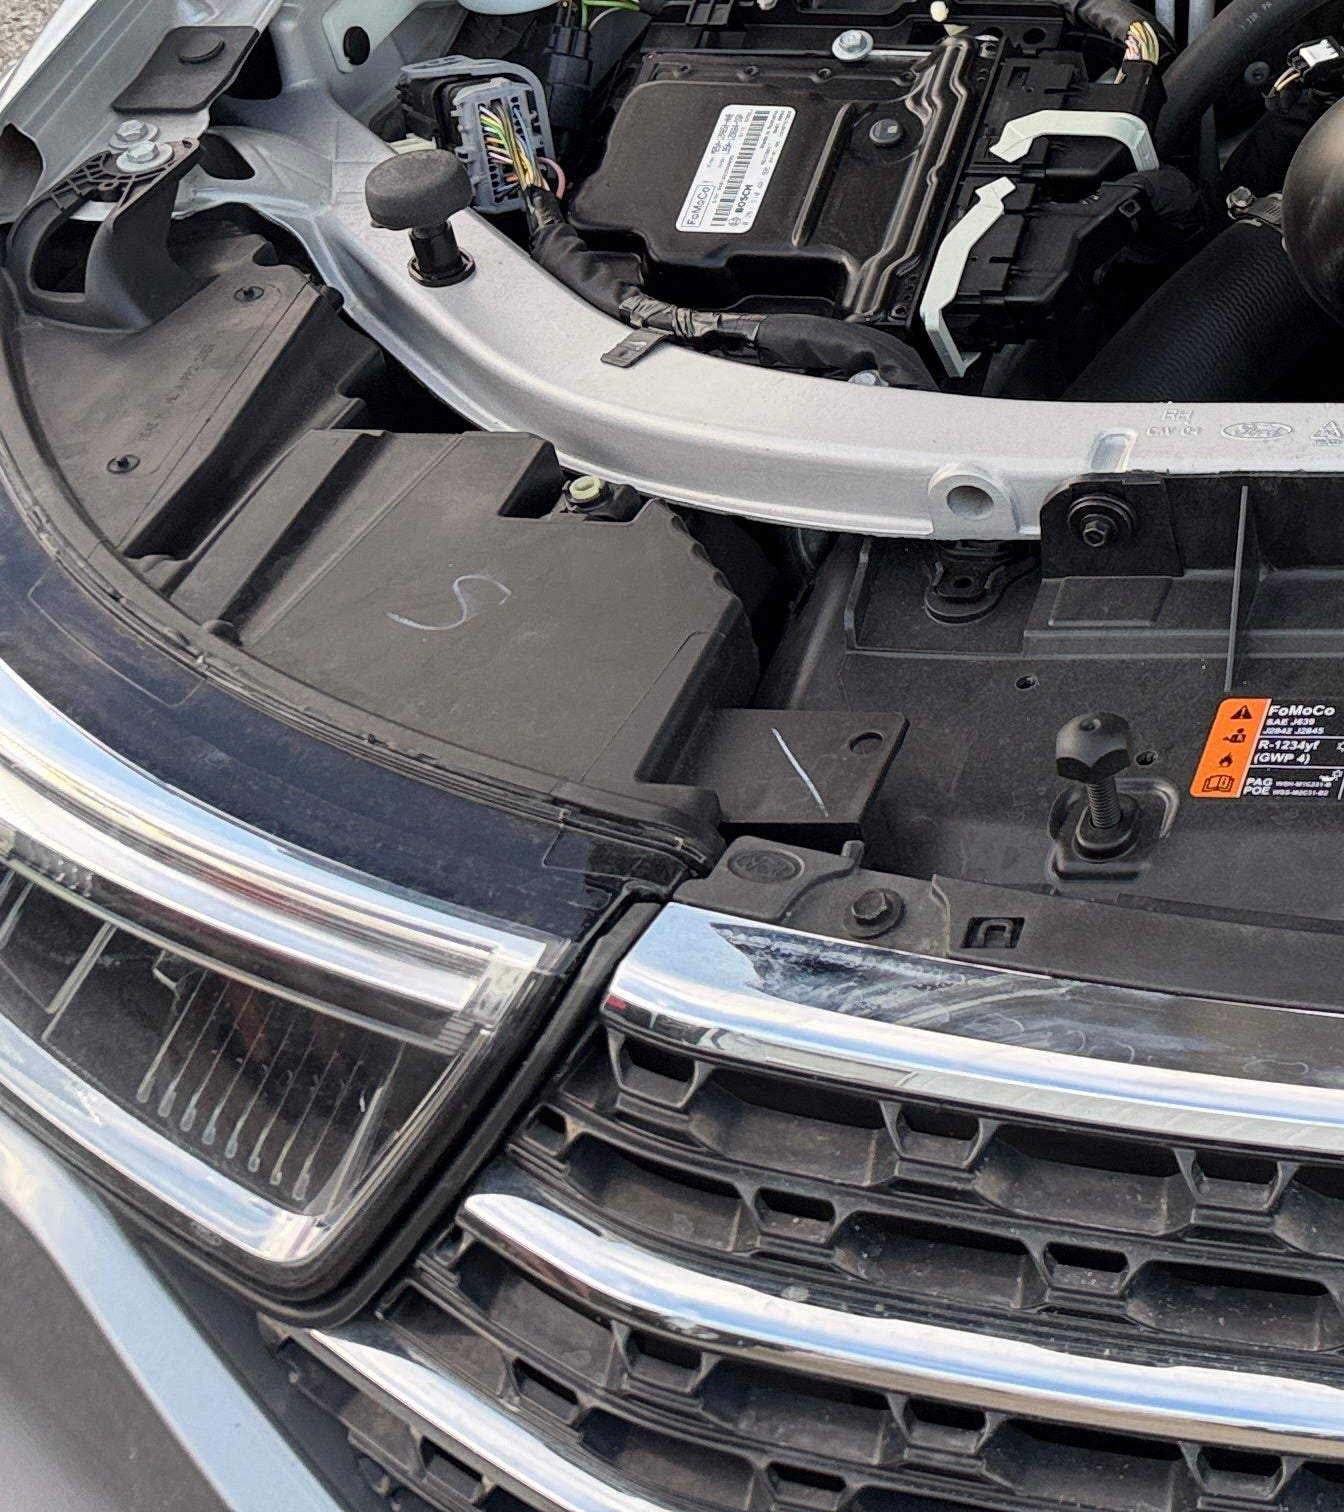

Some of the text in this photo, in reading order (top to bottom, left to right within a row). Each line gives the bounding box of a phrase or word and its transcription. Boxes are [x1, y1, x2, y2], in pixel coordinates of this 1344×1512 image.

[735, 185, 753, 213] BOSCH
[687, 187, 710, 225] FoMoCo
[1268, 705, 1335, 716] FoMoCo
[1258, 740, 1320, 752] R-1234yf
[1254, 753, 1311, 764] (GWP 4)
[1246, 778, 1273, 786] PAG
[1243, 787, 1271, 795] POE
